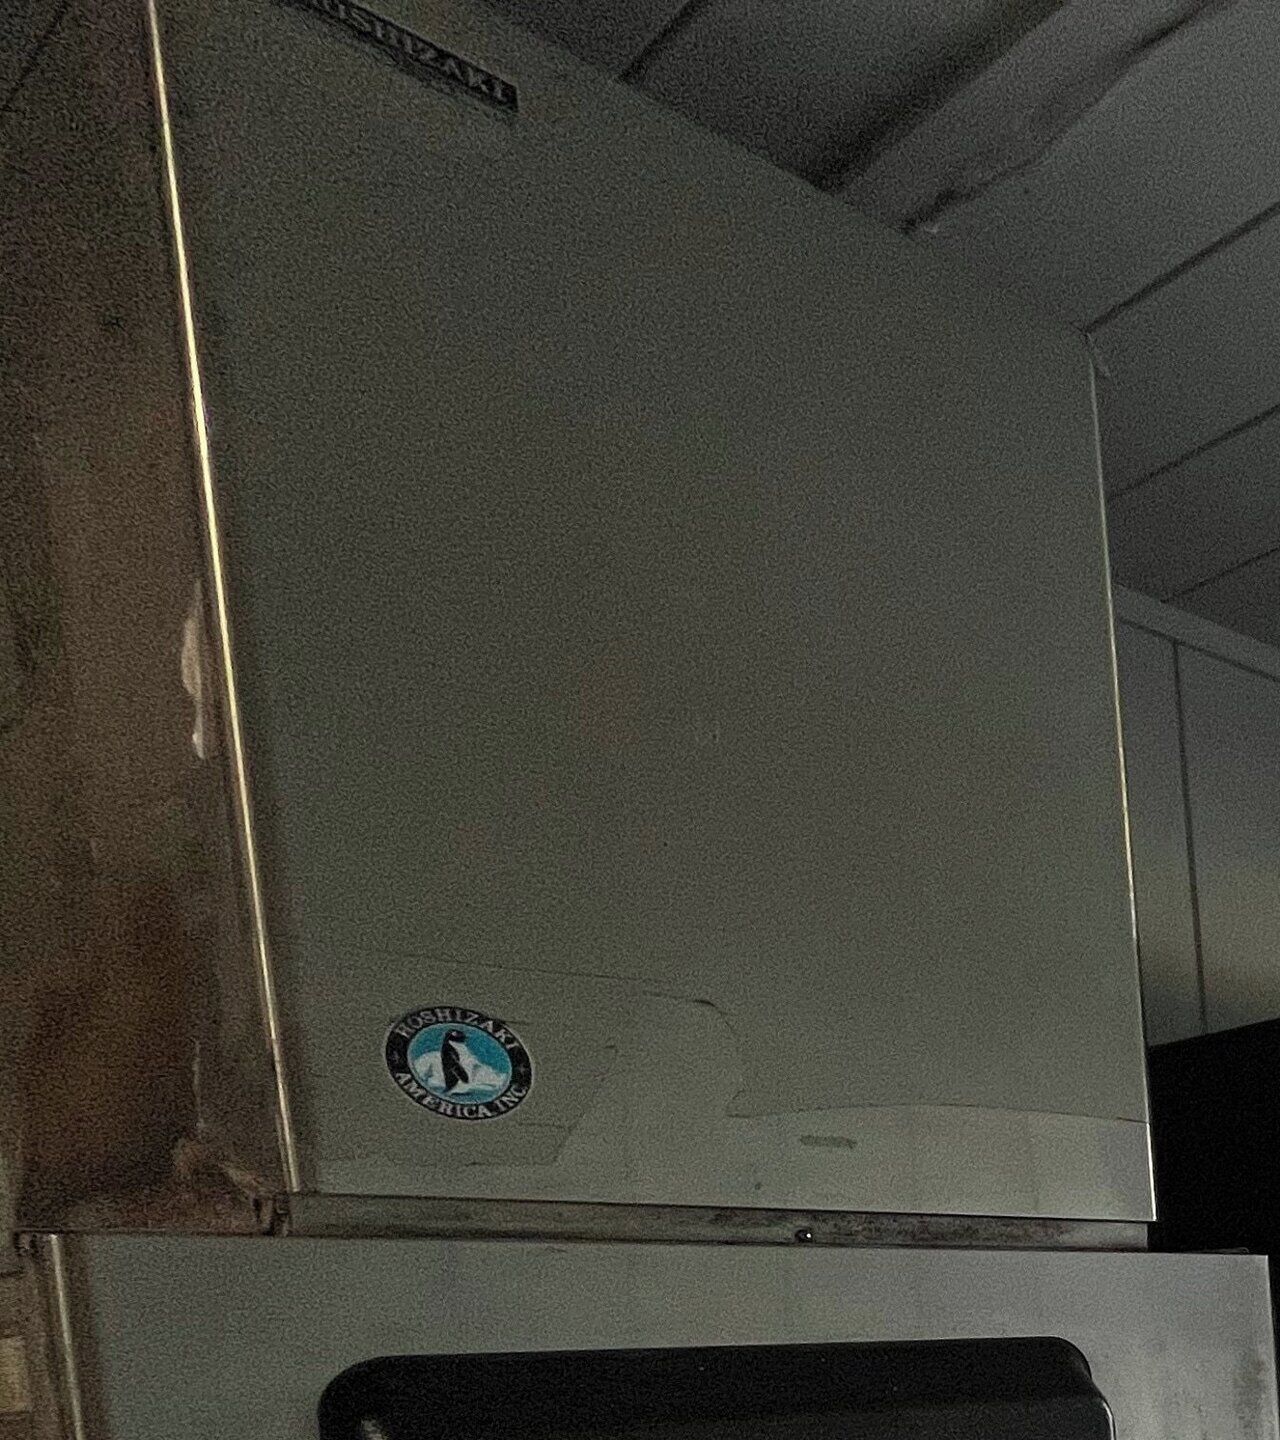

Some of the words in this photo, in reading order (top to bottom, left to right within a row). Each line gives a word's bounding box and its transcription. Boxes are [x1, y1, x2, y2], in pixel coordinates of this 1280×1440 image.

[300, 0, 504, 98] OSHIZAKI
[394, 1008, 520, 1050] HOSHIZAKI
[395, 1071, 492, 1118] AMERICA
